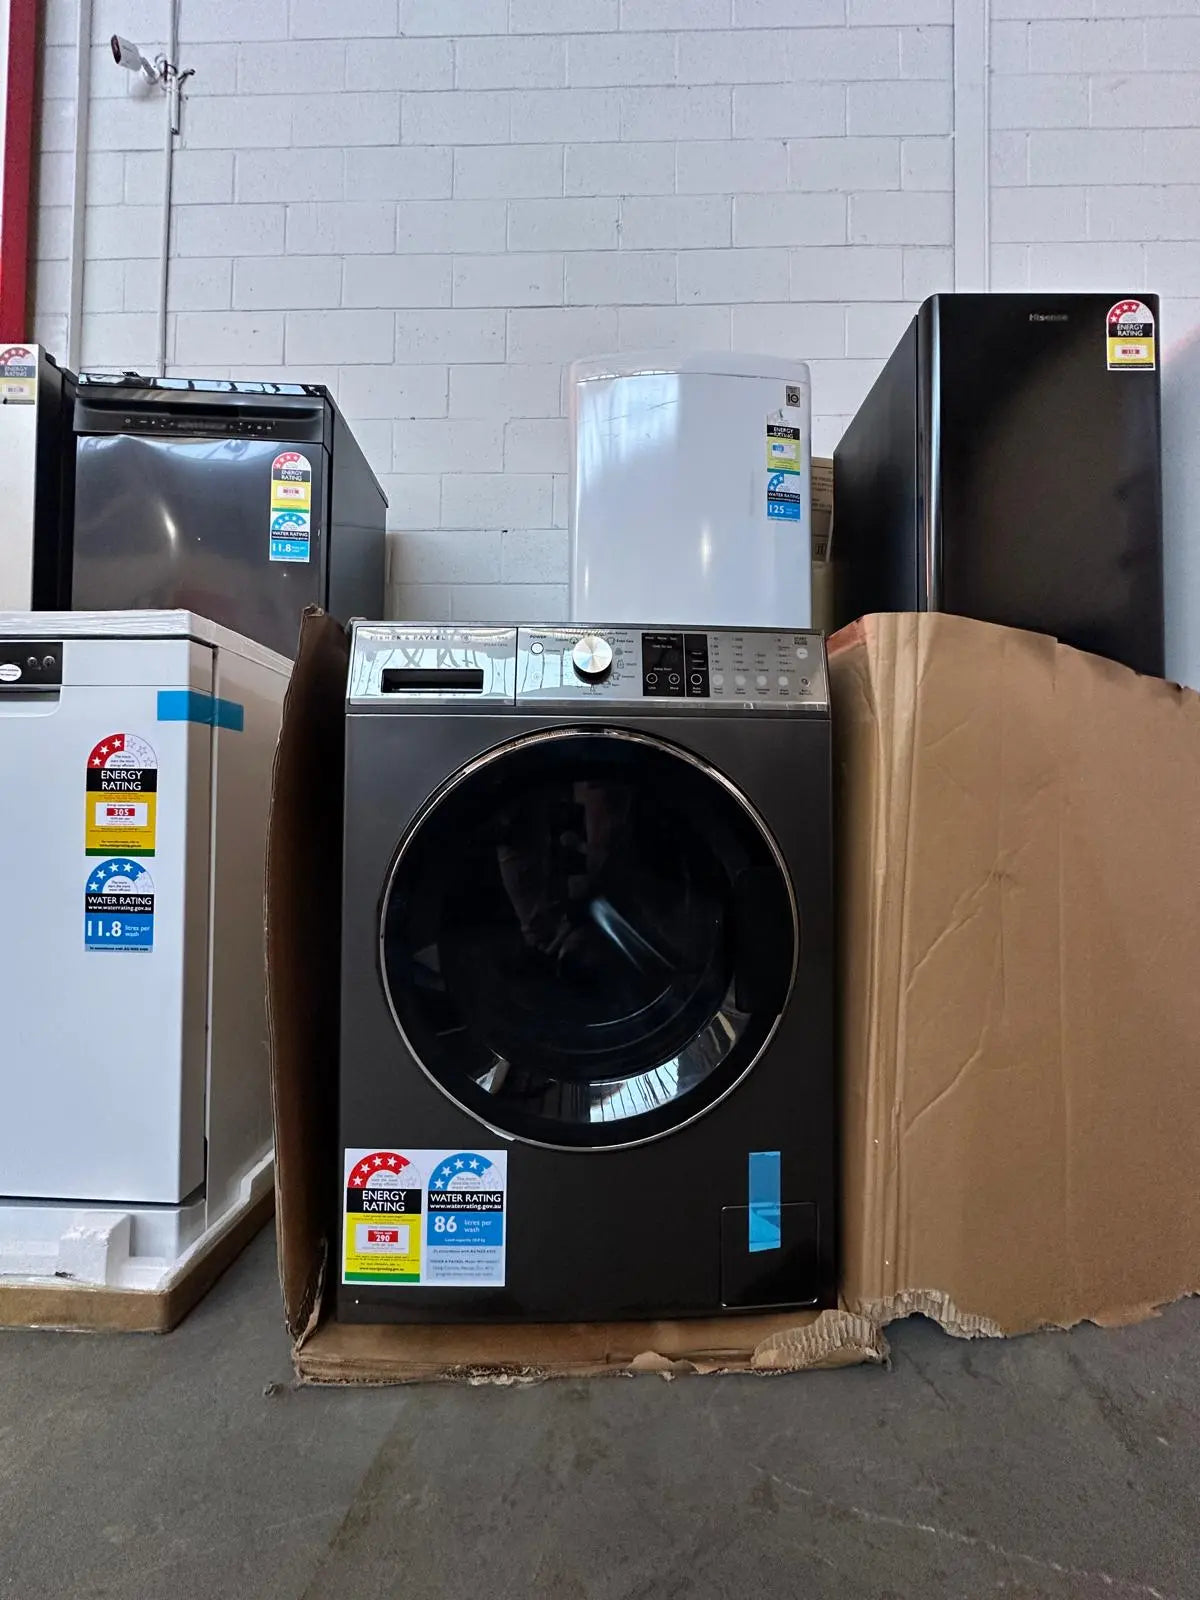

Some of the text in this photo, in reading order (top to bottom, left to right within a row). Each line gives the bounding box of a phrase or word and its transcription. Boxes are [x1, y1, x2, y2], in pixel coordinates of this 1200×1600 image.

[773, 426, 794, 434] ENERGY
[769, 504, 785, 514] 125
[272, 543, 292, 553] 11.8
[101, 770, 143, 780] ENERGY
[101, 781, 142, 791] RATING
[113, 808, 129, 816] 305
[87, 896, 152, 906] WATER RATING
[87, 920, 122, 937] 11.8
[362, 1190, 407, 1201] ENERGY
[430, 1193, 501, 1203] WATER RATING
[363, 1201, 405, 1212] RATING
[434, 1215, 458, 1233] 86
[481, 1220, 492, 1228] per
[375, 1234, 391, 1243] 290
